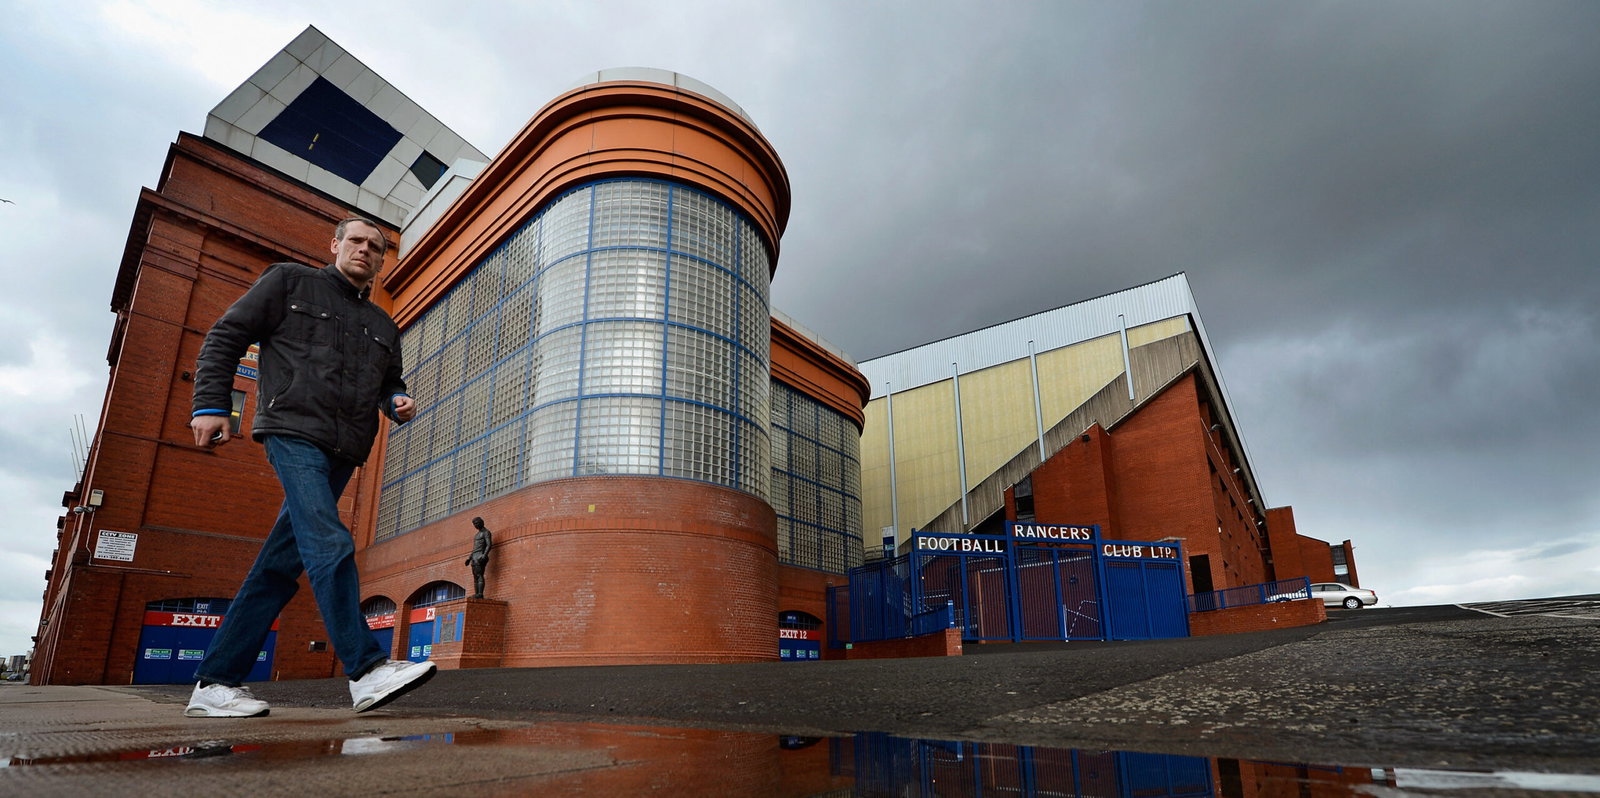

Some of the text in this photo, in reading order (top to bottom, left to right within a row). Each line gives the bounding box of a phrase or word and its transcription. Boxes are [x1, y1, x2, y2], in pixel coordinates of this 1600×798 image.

[1014, 524, 1090, 540] RANGERS
[918, 537, 1004, 553] FOOTBALL
[1104, 544, 1142, 558] CLUB
[171, 614, 220, 627] EXIT
[780, 630, 808, 639] EXIT 12
